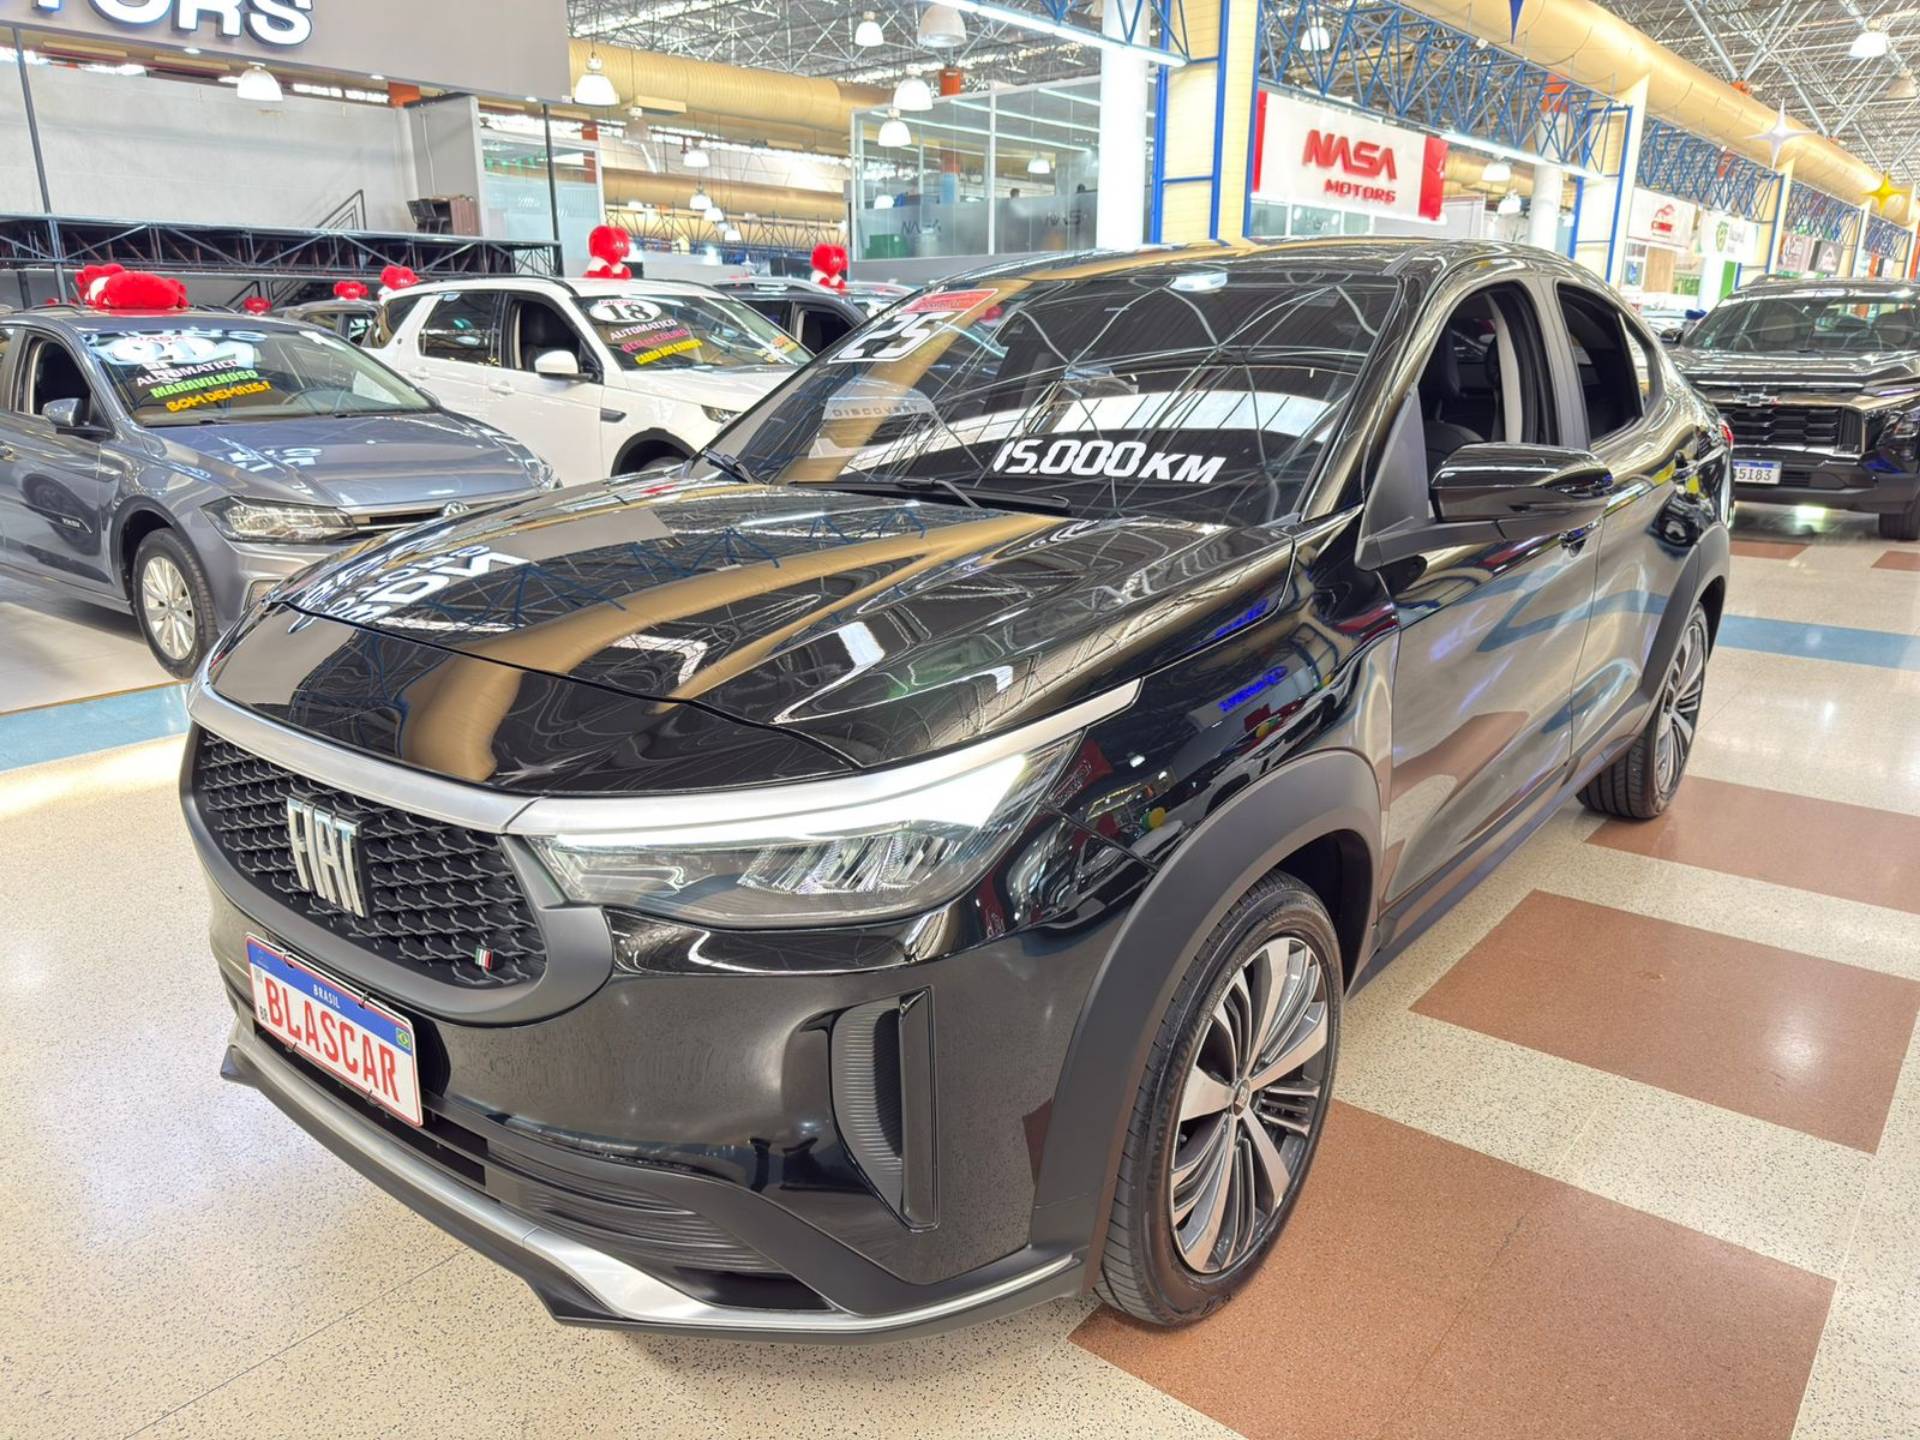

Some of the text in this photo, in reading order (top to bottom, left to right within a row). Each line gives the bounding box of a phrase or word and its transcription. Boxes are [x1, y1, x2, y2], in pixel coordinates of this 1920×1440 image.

[1302, 129, 1397, 181] NASA
[1325, 179, 1396, 204] MOTORS
[603, 304, 652, 320] 18
[839, 312, 956, 359] 25
[166, 393, 207, 412] BOM
[993, 439, 1227, 484] 15.000 KM
[287, 797, 365, 918] FIAT
[313, 984, 341, 1009] BRASIL
[265, 977, 400, 1104] BLASCAR
